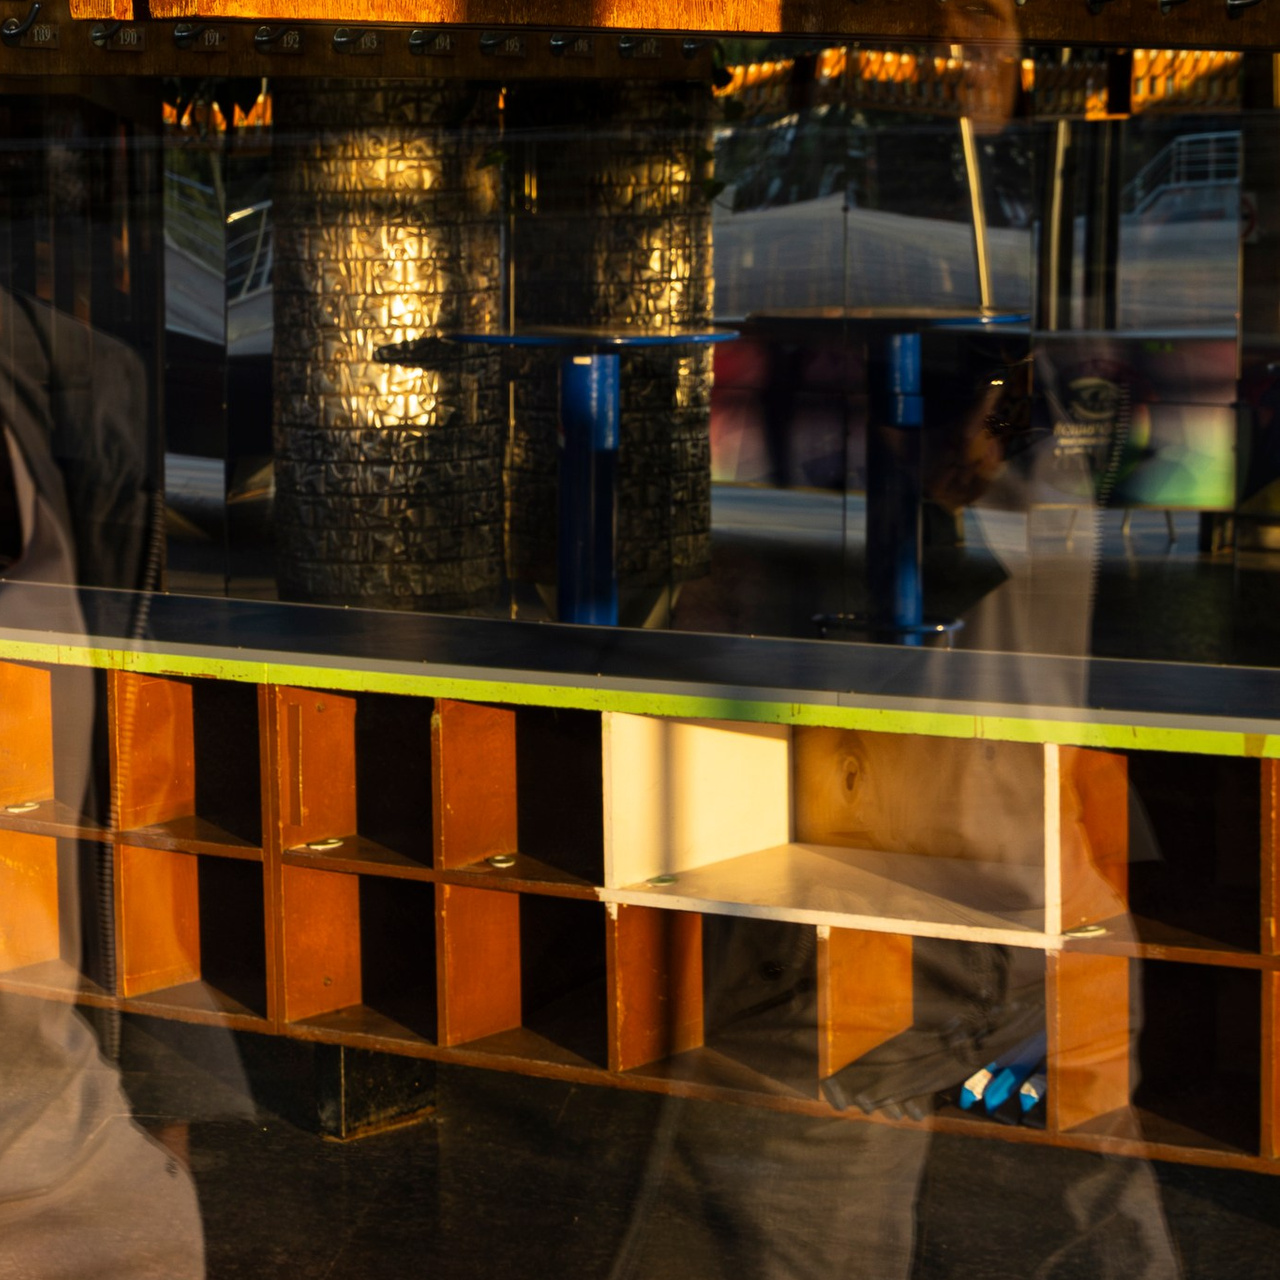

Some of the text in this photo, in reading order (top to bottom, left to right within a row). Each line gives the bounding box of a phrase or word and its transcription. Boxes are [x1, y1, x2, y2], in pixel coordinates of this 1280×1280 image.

[32, 24, 51, 42] 189
[120, 30, 137, 45] 190
[204, 30, 219, 46] 191
